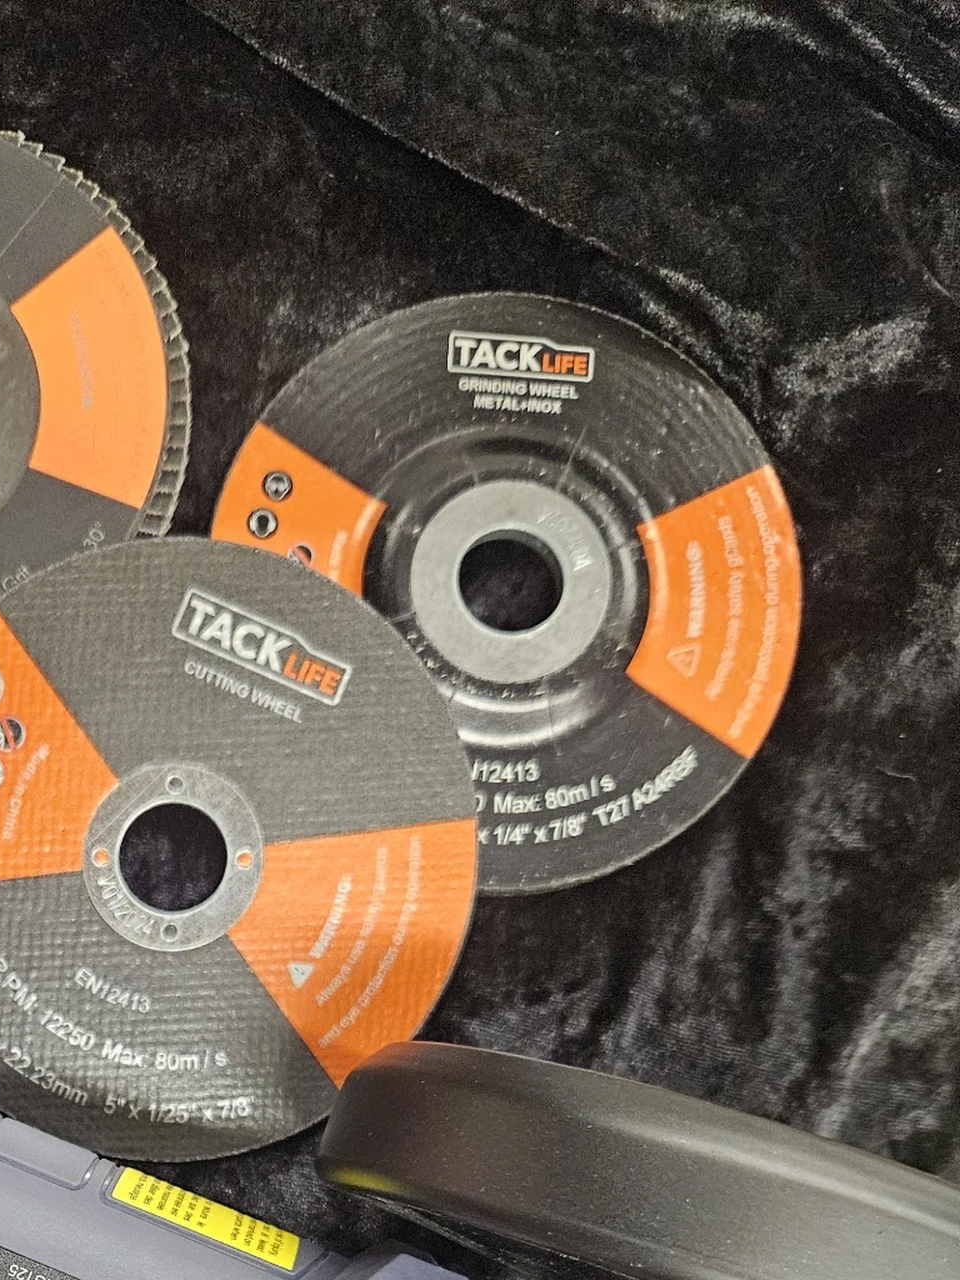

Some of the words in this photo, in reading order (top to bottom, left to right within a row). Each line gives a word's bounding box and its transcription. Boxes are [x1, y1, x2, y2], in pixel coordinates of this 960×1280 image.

[458, 376, 528, 396] GRINDING
[529, 382, 580, 400] WHEEL
[184, 659, 250, 699] CUTTING
[250, 685, 303, 724] WHEEL
[592, 794, 631, 827] T27
[74, 967, 151, 1013] EN12413
[314, 965, 352, 1008] Always
[348, 937, 368, 966] use
[317, 1023, 341, 1050] and
[339, 1004, 362, 1030] eye
[358, 946, 399, 1009] protection
[393, 902, 418, 946] during
[40, 1009, 96, 1051] 12250
[3, 1046, 89, 1106] 22.23mm
[127, 1104, 142, 1121] x
[201, 1107, 215, 1123] x
